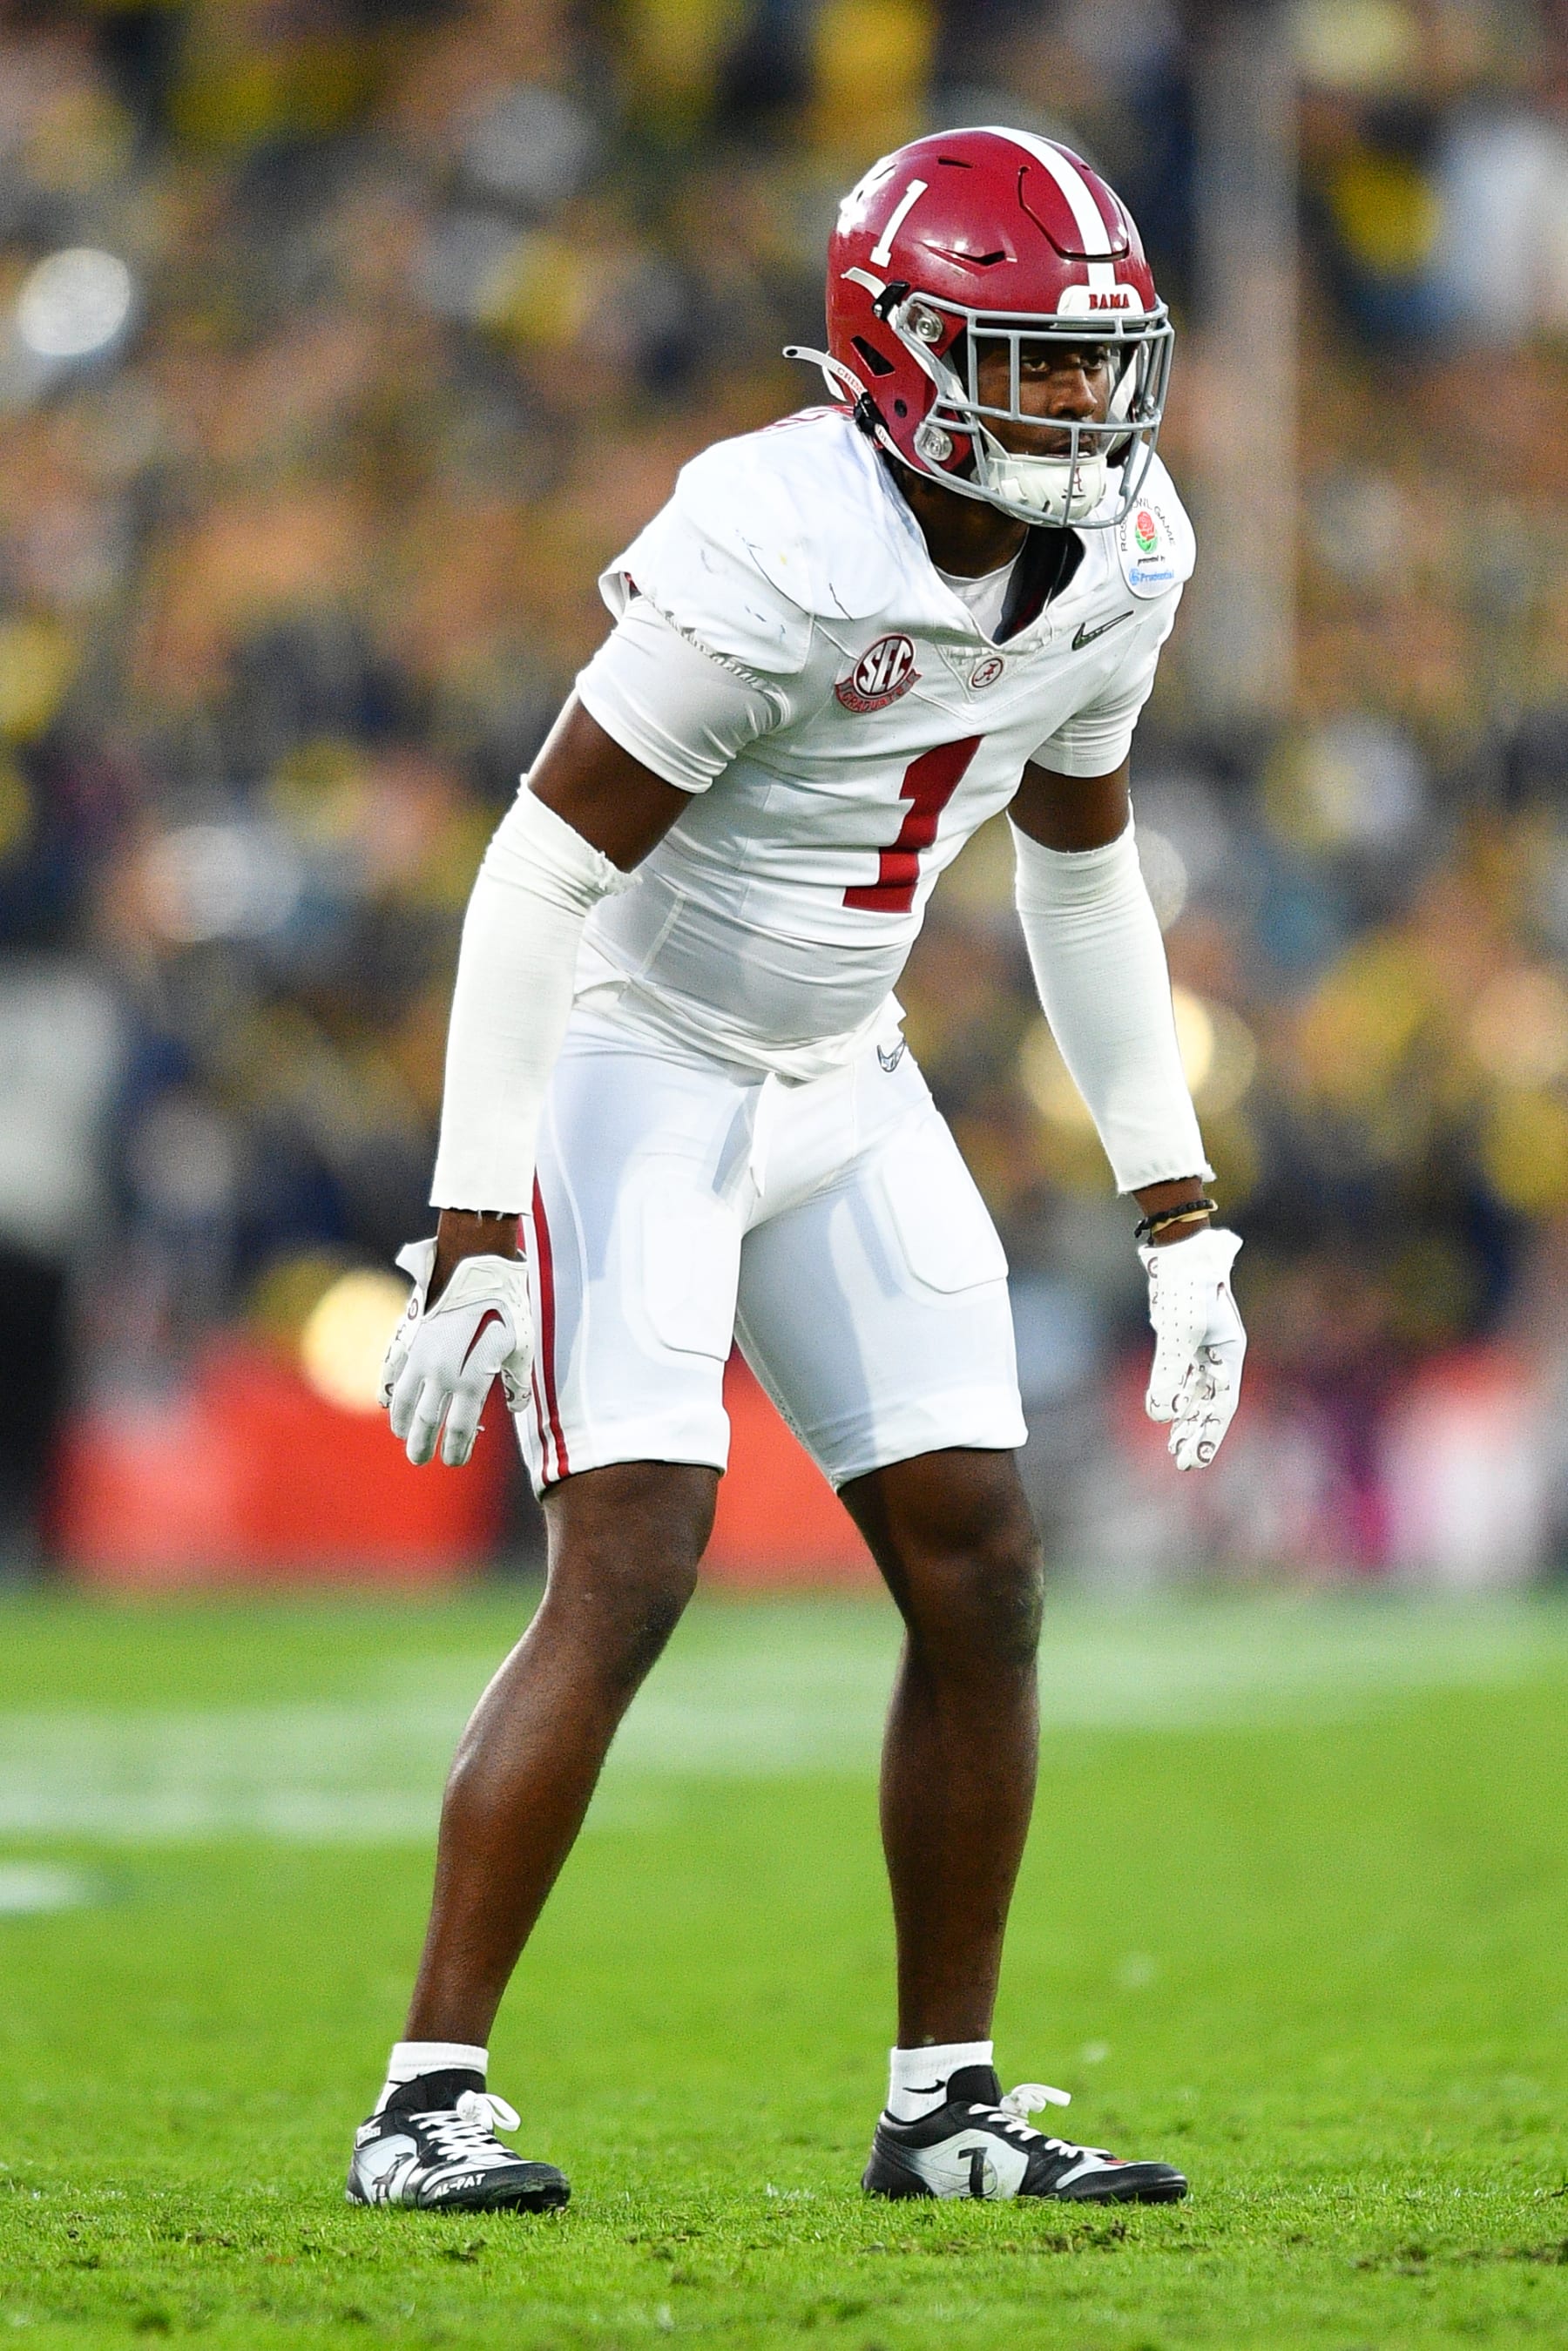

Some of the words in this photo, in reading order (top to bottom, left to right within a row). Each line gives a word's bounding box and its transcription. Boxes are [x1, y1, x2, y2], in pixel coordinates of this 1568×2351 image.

[870, 179, 929, 268] 1
[1088, 294, 1131, 310] BAMA
[858, 639, 912, 693] SEC
[842, 734, 983, 913] 1
